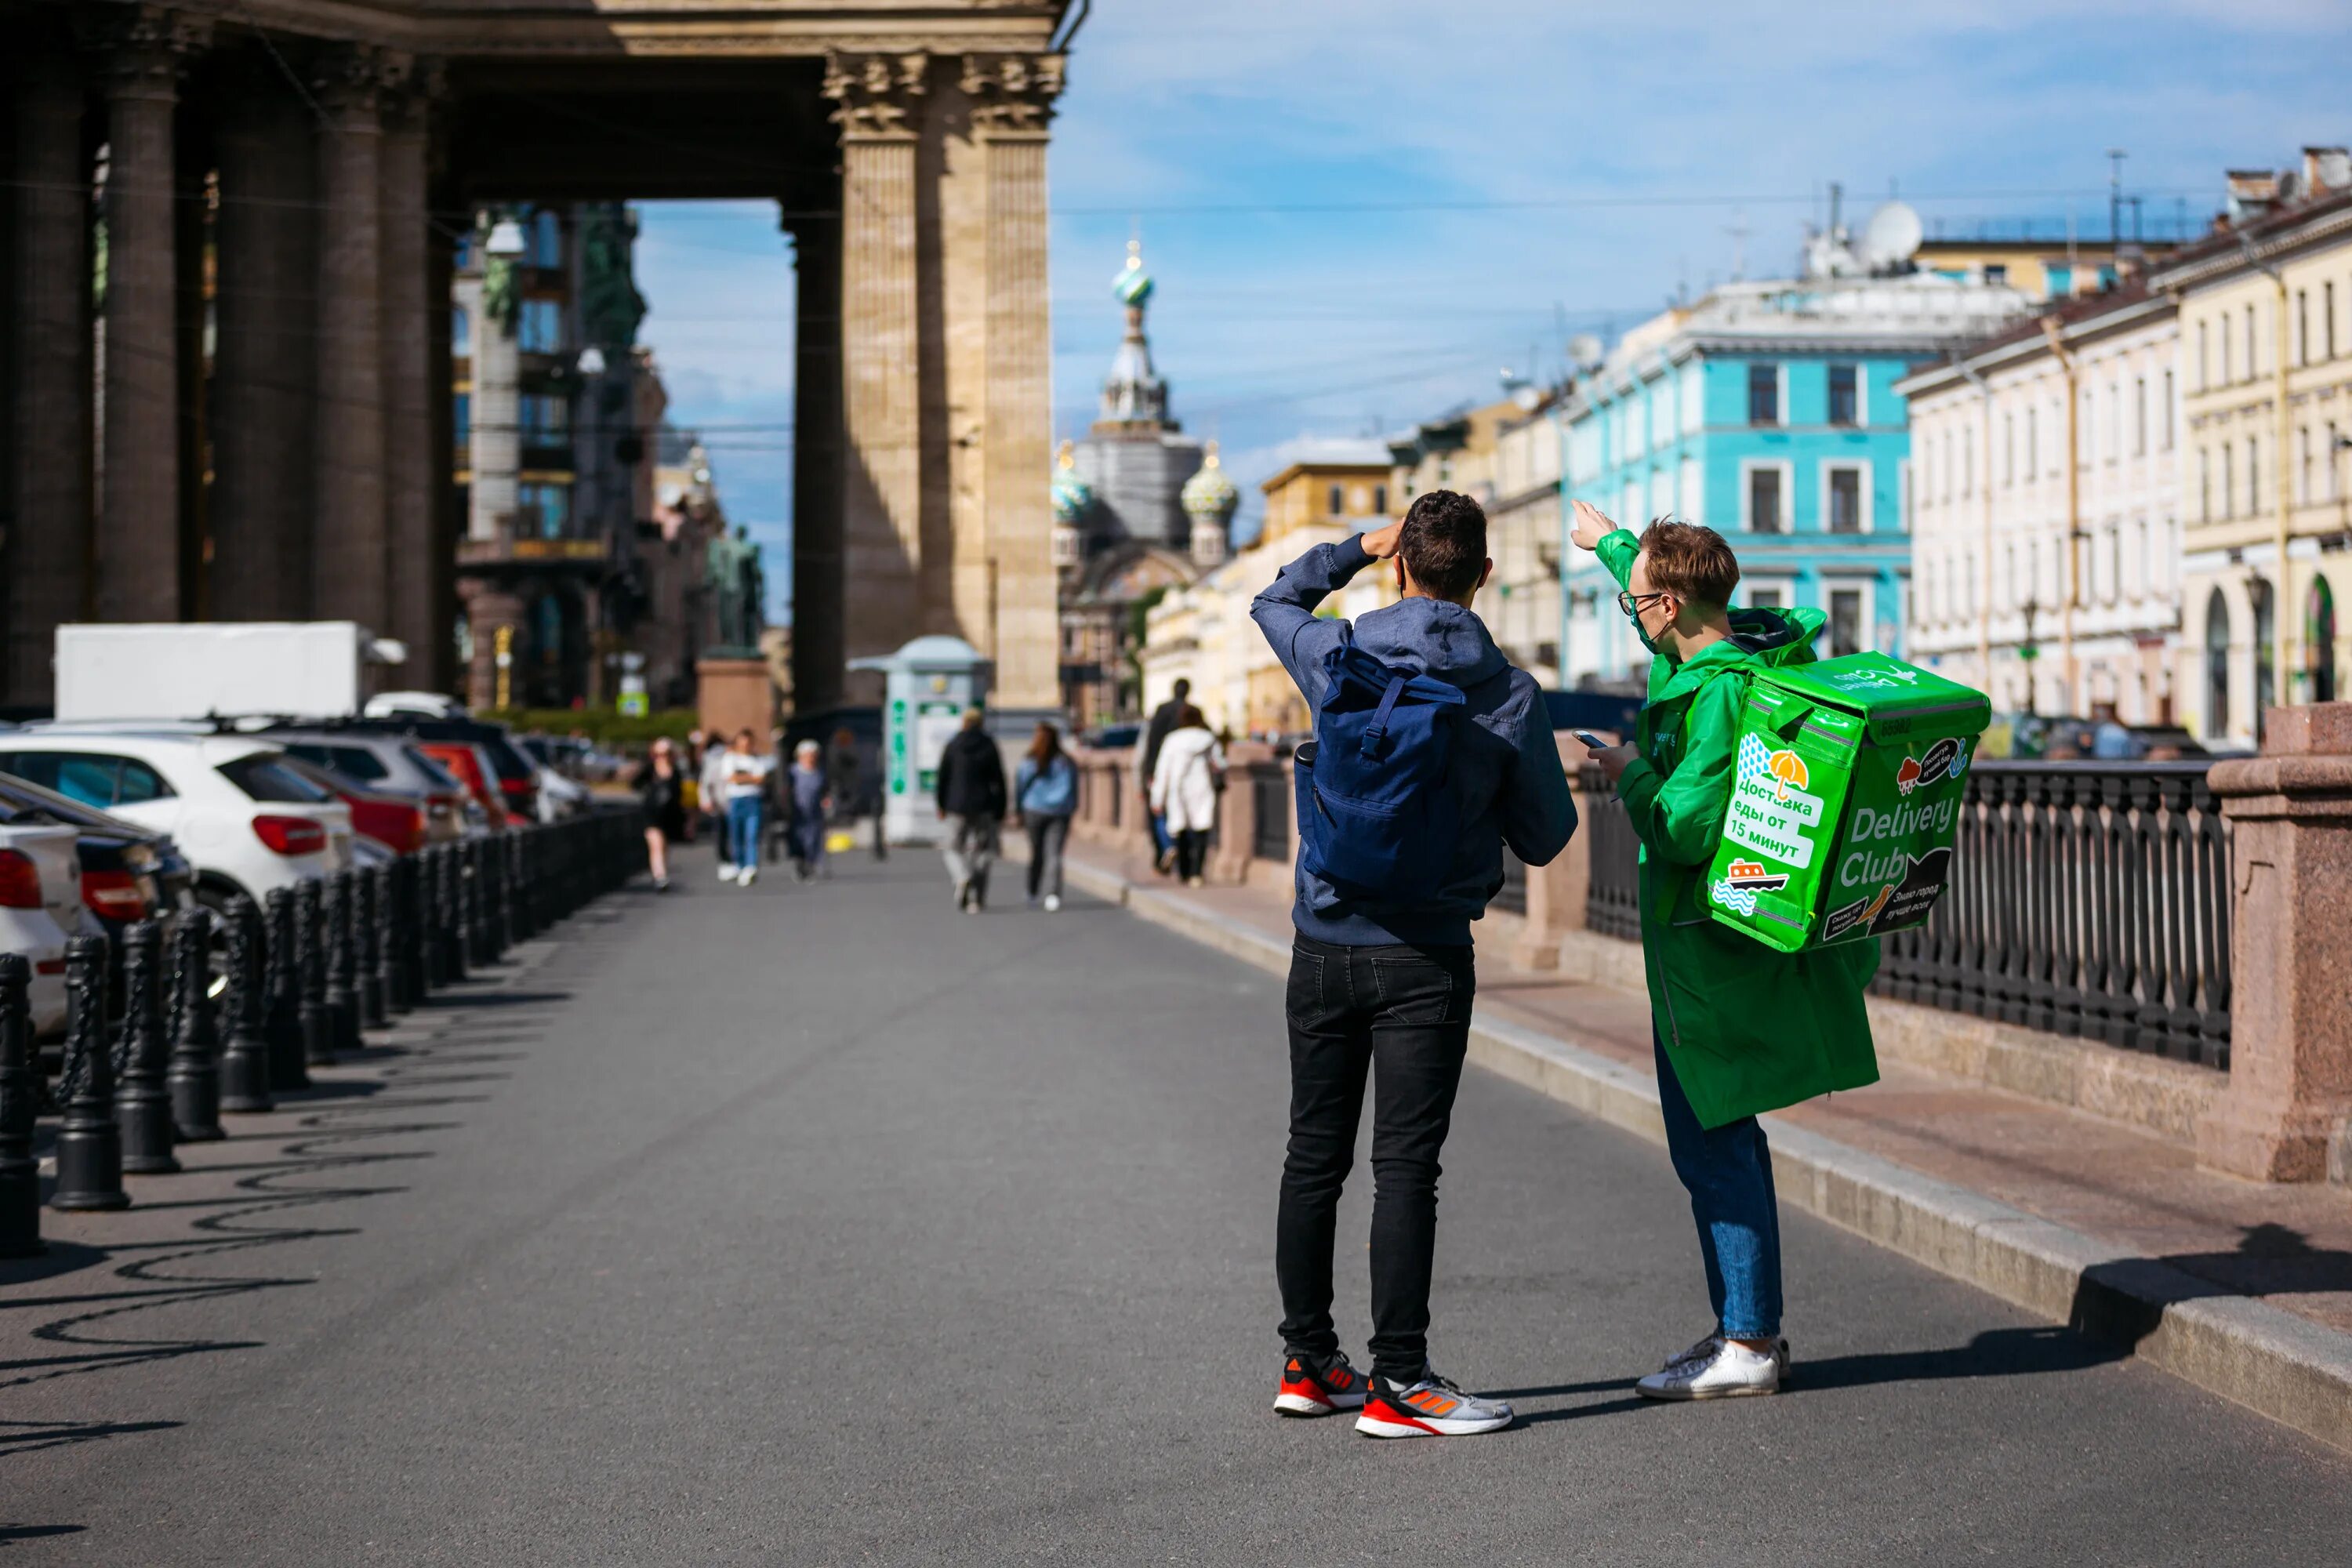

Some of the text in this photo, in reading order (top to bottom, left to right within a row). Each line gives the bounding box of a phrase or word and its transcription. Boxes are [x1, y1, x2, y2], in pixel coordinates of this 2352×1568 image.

[1923, 754, 1951, 778] лучший бар
[1924, 744, 1949, 768] Посоветую
[1734, 800, 1788, 830] еды от
[1850, 797, 1955, 843] Delivery
[1732, 819, 1799, 858] 15 минут
[1840, 847, 1905, 887] Club
[1893, 884, 1940, 902] Знаю город
[1885, 905, 1911, 920] лучше
